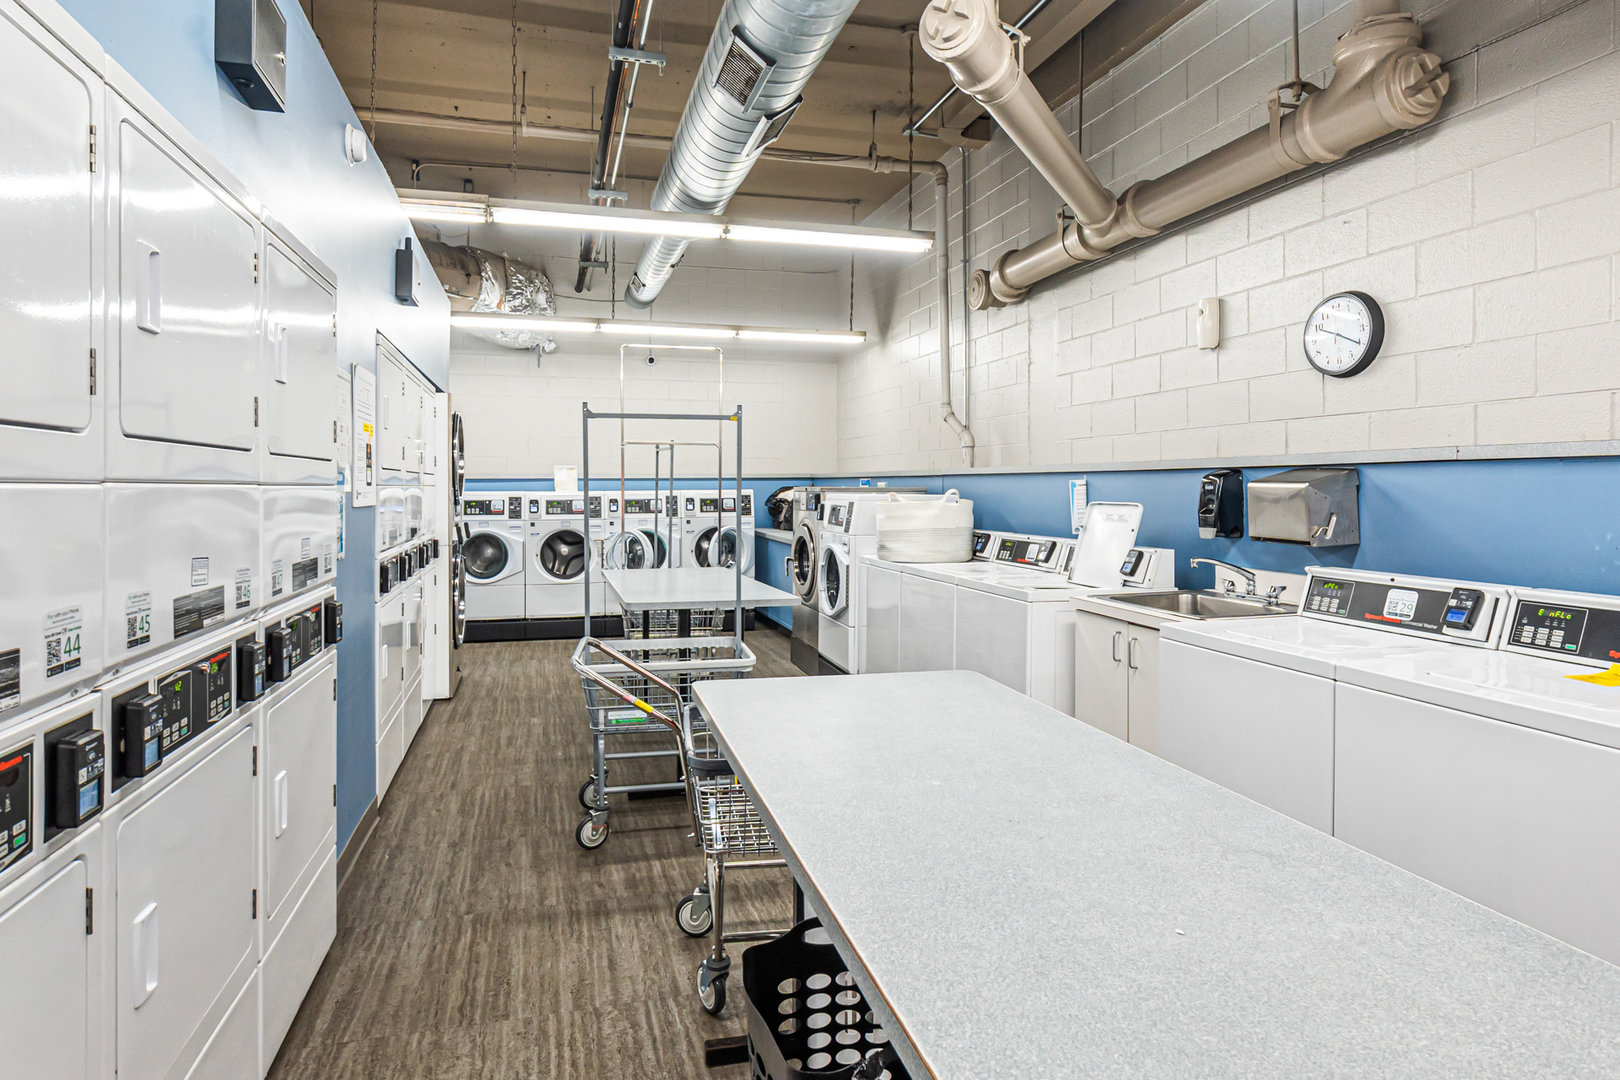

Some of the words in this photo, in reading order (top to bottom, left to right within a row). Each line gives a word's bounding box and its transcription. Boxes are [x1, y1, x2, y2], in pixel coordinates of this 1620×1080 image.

[1321, 312, 1329, 321] 11
[1315, 323, 1324, 333] 10
[1336, 356, 1343, 365] 6
[242, 584, 251, 599] 46
[1399, 602, 1413, 613] 29
[138, 614, 151, 634] 45
[63, 633, 82, 658] 44
